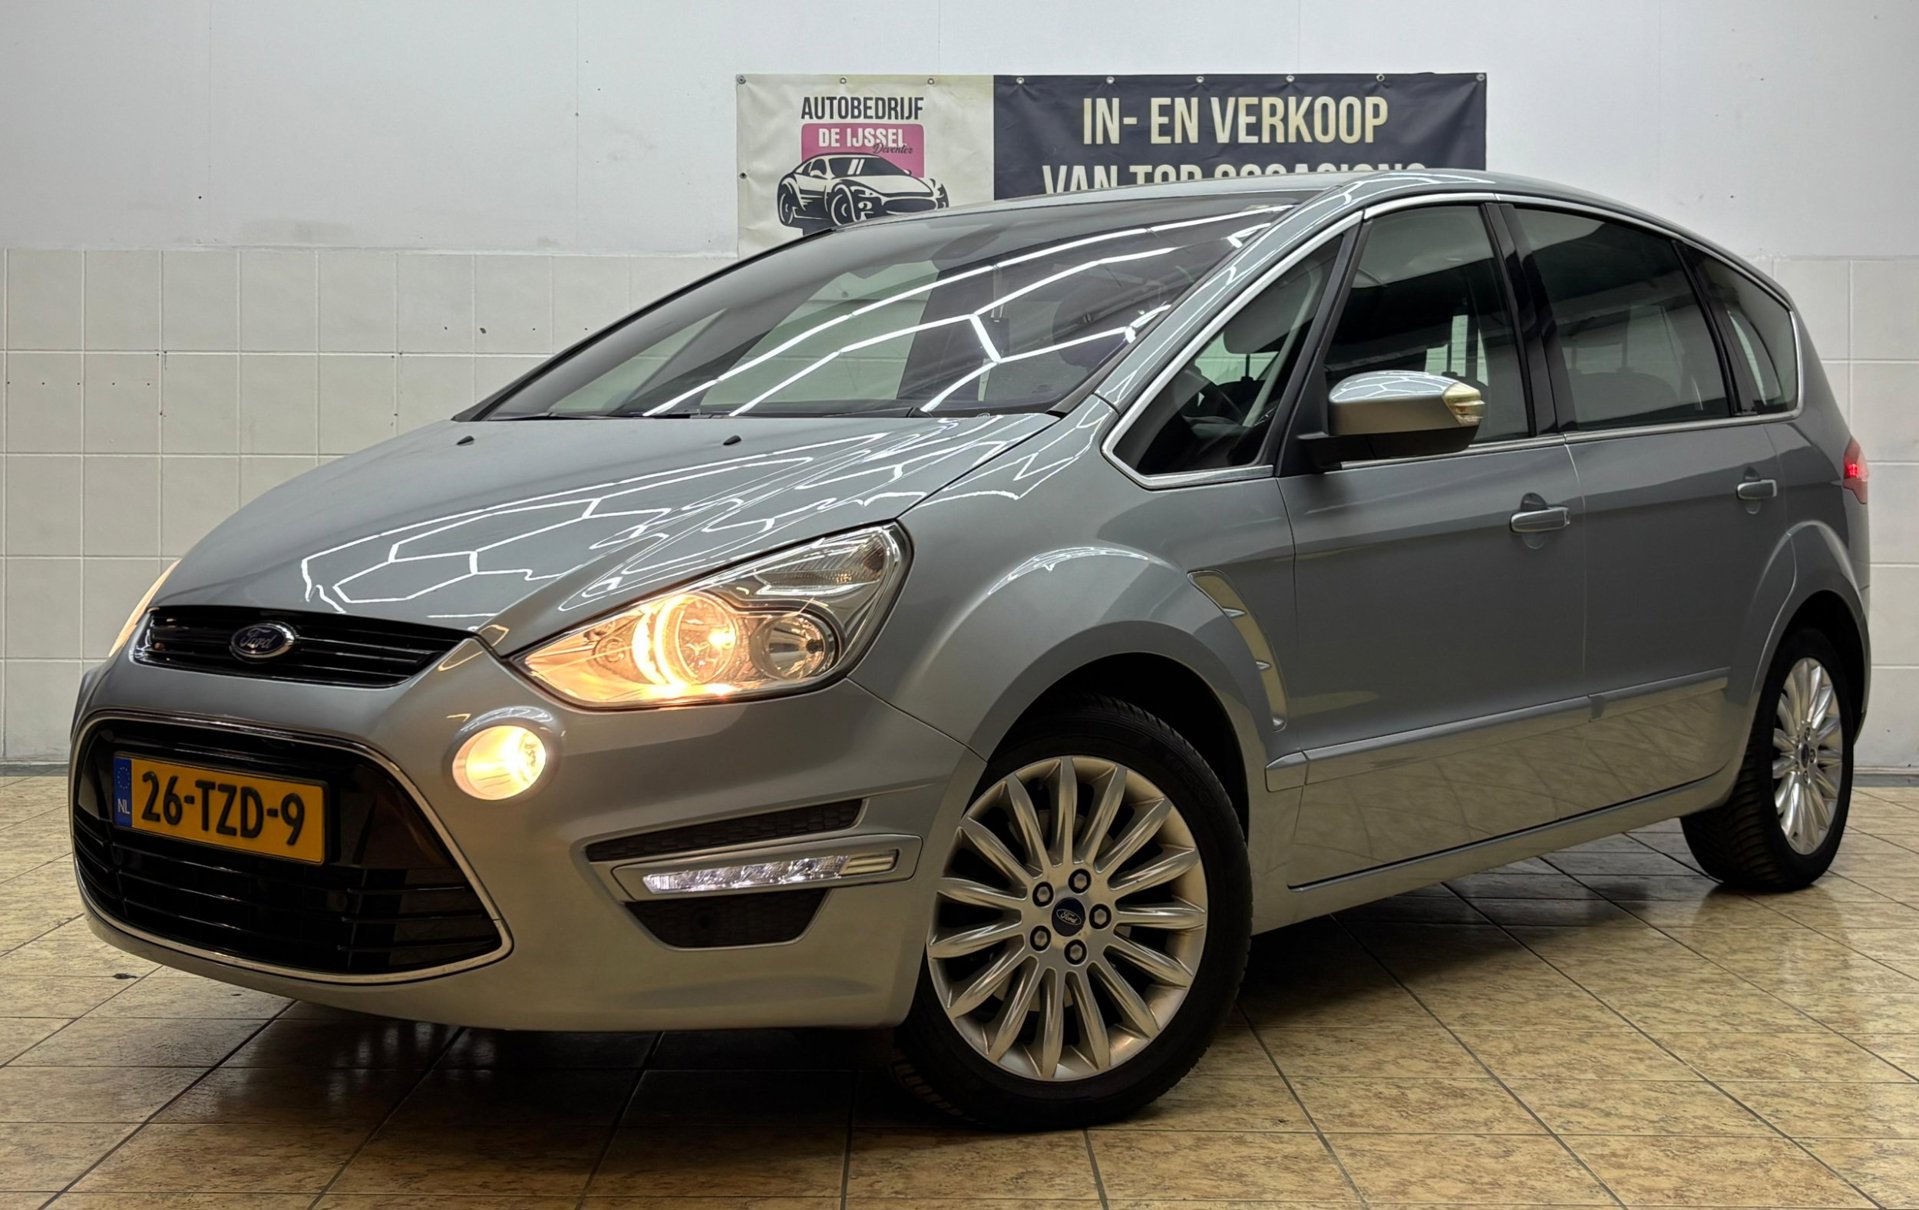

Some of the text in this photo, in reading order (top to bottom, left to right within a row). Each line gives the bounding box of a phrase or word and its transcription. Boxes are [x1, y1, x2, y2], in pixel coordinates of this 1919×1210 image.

[801, 96, 924, 120] AUTOBEDRIJF
[1083, 96, 1389, 145] IN- EN VERKOOP
[818, 128, 907, 148] DE IJSSEL
[872, 143, 913, 154] Deventer
[117, 798, 131, 815] NL
[141, 771, 305, 846] 26-TZD-9
